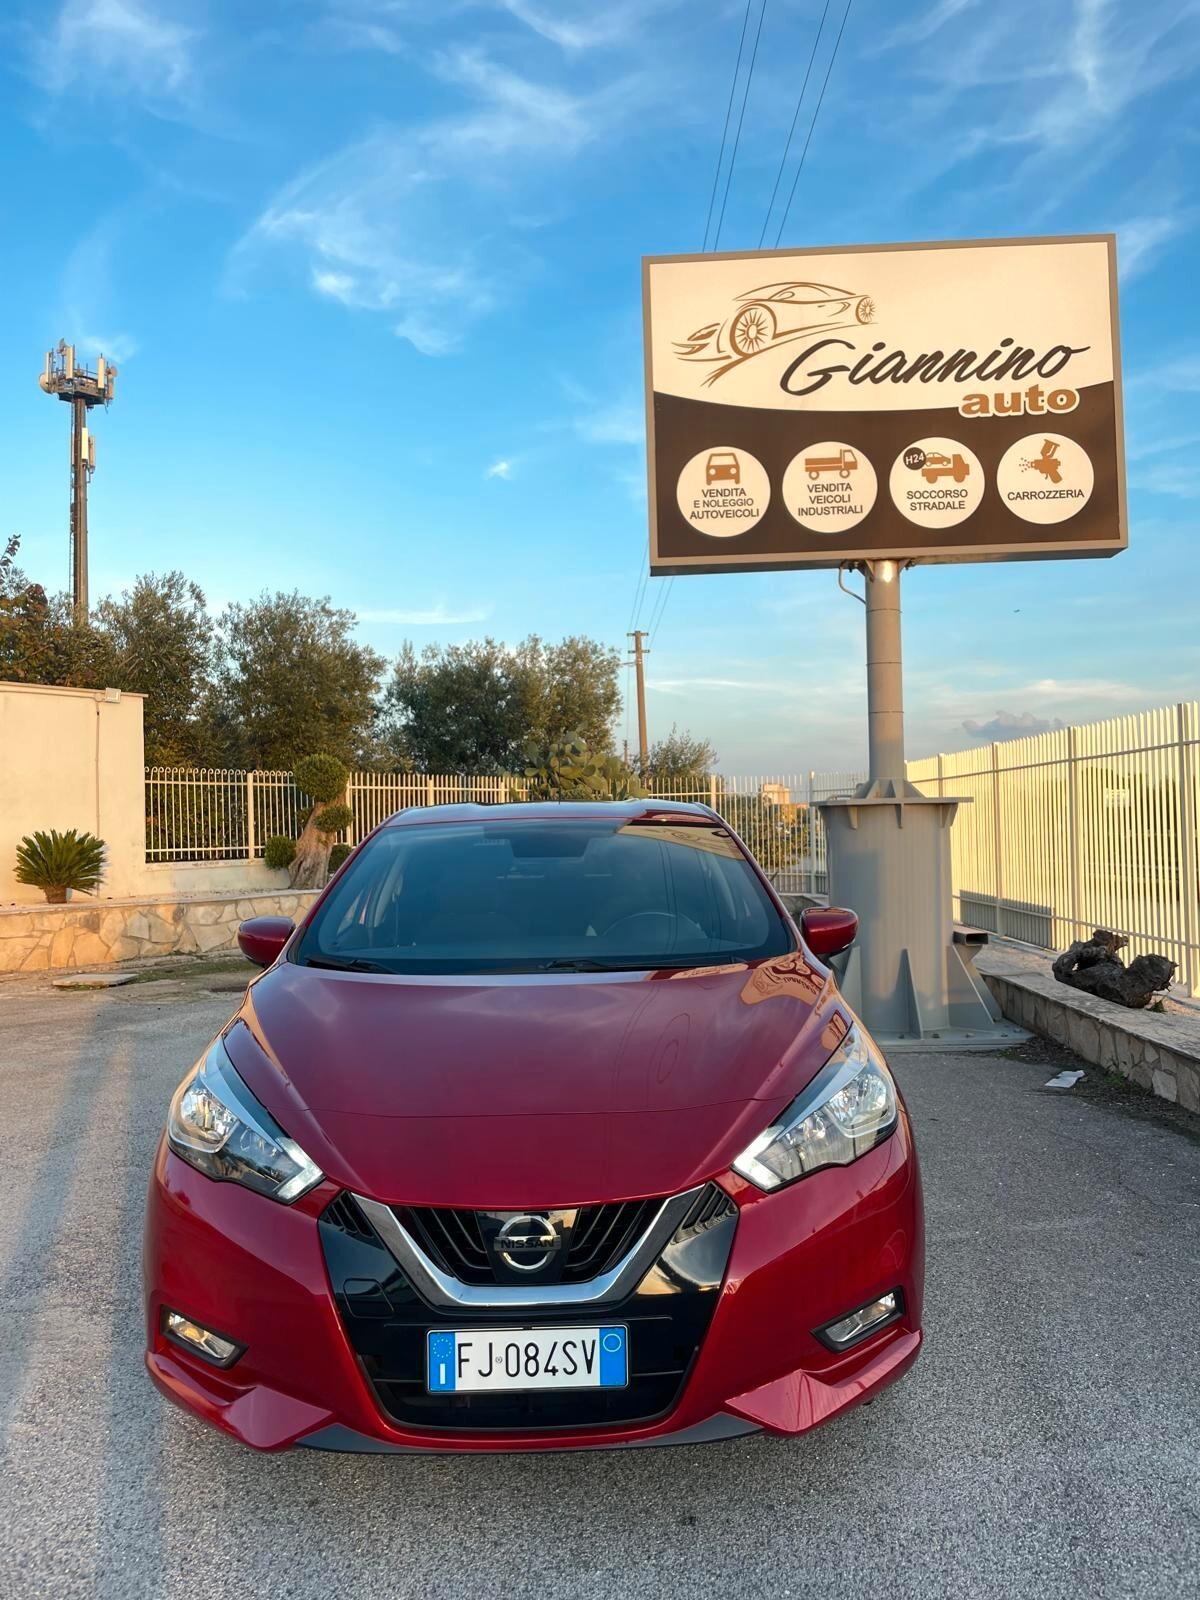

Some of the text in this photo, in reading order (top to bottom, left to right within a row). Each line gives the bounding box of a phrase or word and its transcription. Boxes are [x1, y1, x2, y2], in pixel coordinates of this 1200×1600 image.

[779, 337, 1091, 396] Giannino
[961, 384, 1077, 415] auto
[905, 453, 925, 465] H24
[702, 488, 747, 498] VENDITA
[807, 482, 853, 493] VENDITA
[809, 494, 851, 504] VEICOLI
[906, 489, 968, 499] SOCCORSO
[1007, 489, 1085, 501] CARROZZERIA
[693, 498, 754, 508] E NOLEGGIO
[910, 501, 966, 511] STRADALE
[689, 508, 760, 519] AUTOVEICOLI
[798, 505, 863, 516] INDUSTRIALI
[501, 1239, 554, 1249] NISSAN
